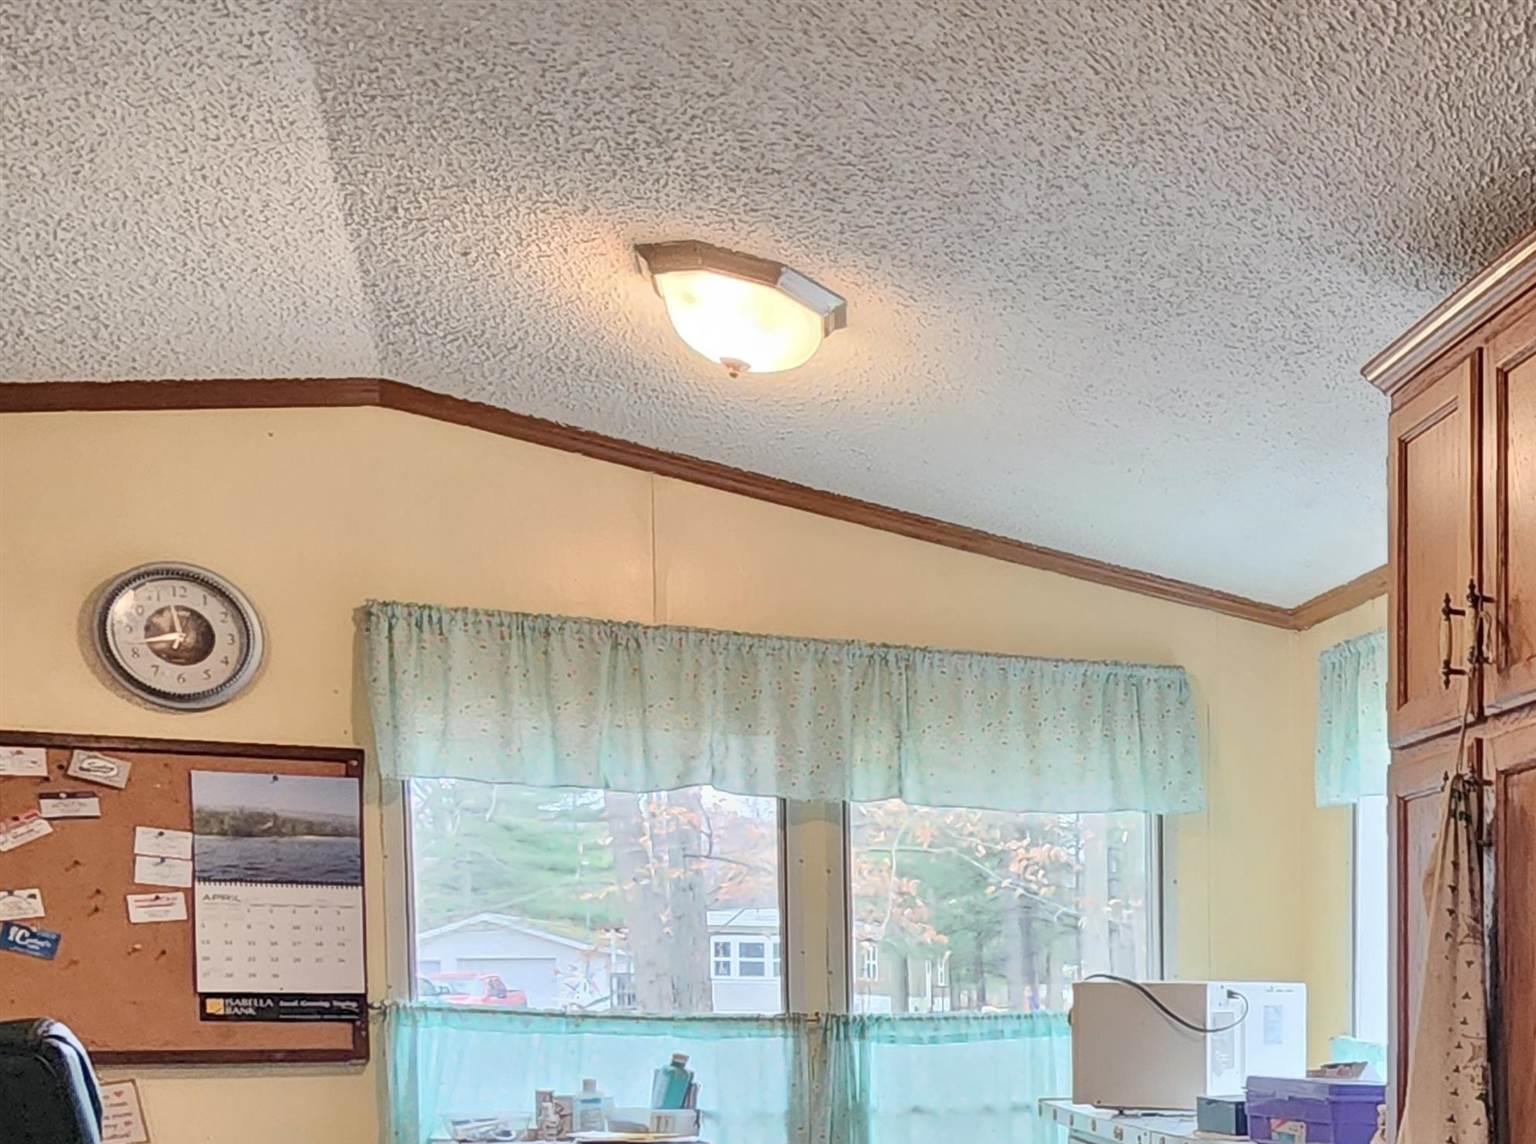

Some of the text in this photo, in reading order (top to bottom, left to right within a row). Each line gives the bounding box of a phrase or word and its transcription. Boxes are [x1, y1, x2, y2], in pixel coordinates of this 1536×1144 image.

[171, 585, 188, 598] 12
[202, 593, 208, 606] 1
[220, 611, 228, 623] 2
[227, 633, 235, 646] 3
[131, 646, 140, 659] 8
[221, 656, 229, 666] 4
[150, 663, 160, 677] 7
[203, 669, 211, 679] 5
[177, 673, 186, 683] 6
[202, 894, 242, 903] APRIL
[224, 998, 274, 1008] ISABELLA
